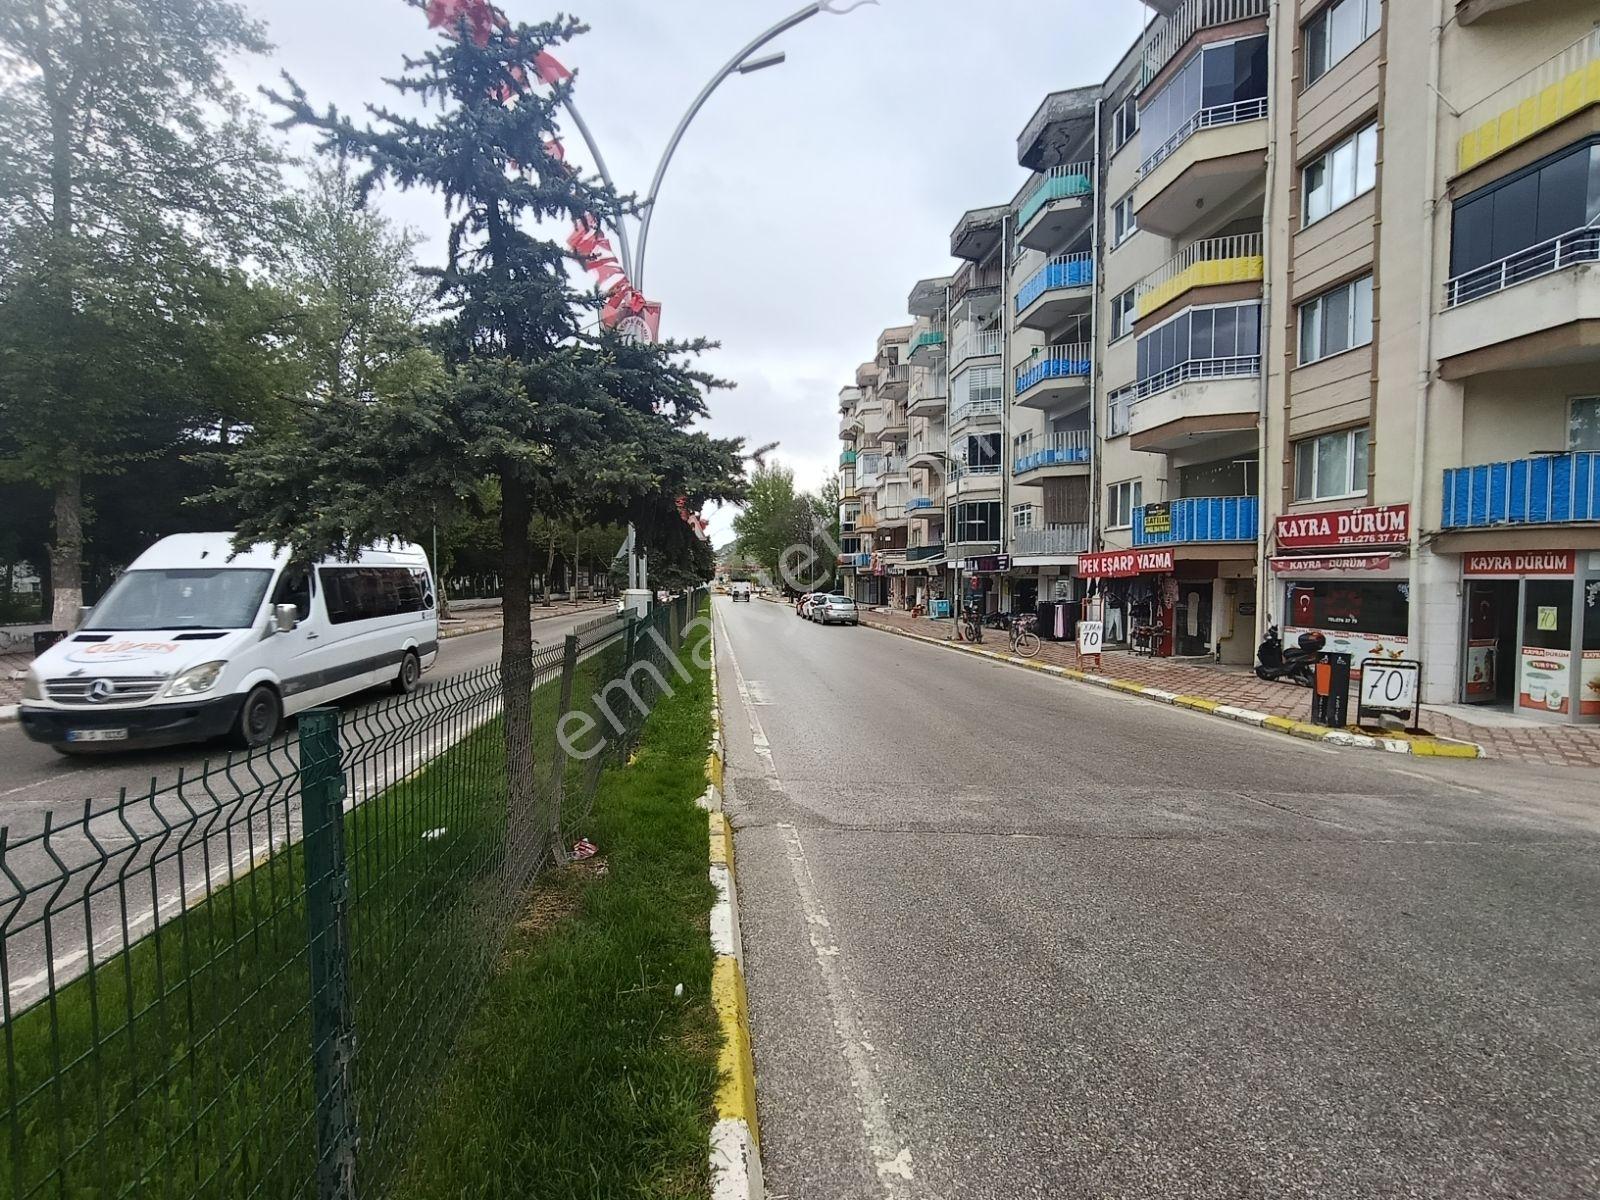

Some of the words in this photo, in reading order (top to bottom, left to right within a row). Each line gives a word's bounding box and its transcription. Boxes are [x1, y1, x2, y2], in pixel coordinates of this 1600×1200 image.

[1278, 518, 1330, 538] KAYRA
[1338, 507, 1405, 534] DÜRÜM
[1338, 534, 1375, 544] TEL:276
[1377, 533, 1391, 543] 37
[1393, 532, 1406, 542] 75
[1079, 557, 1099, 574] İPEK
[1101, 555, 1134, 575] EŞARP
[1137, 553, 1172, 569] YAZMA
[1290, 561, 1321, 570] KAYRA
[1329, 558, 1366, 568] DÜRÜM
[1470, 556, 1511, 570] KAYRA
[1515, 553, 1567, 570] DÜRÜM
[1083, 632, 1099, 646] 70
[1369, 669, 1403, 701] 70
